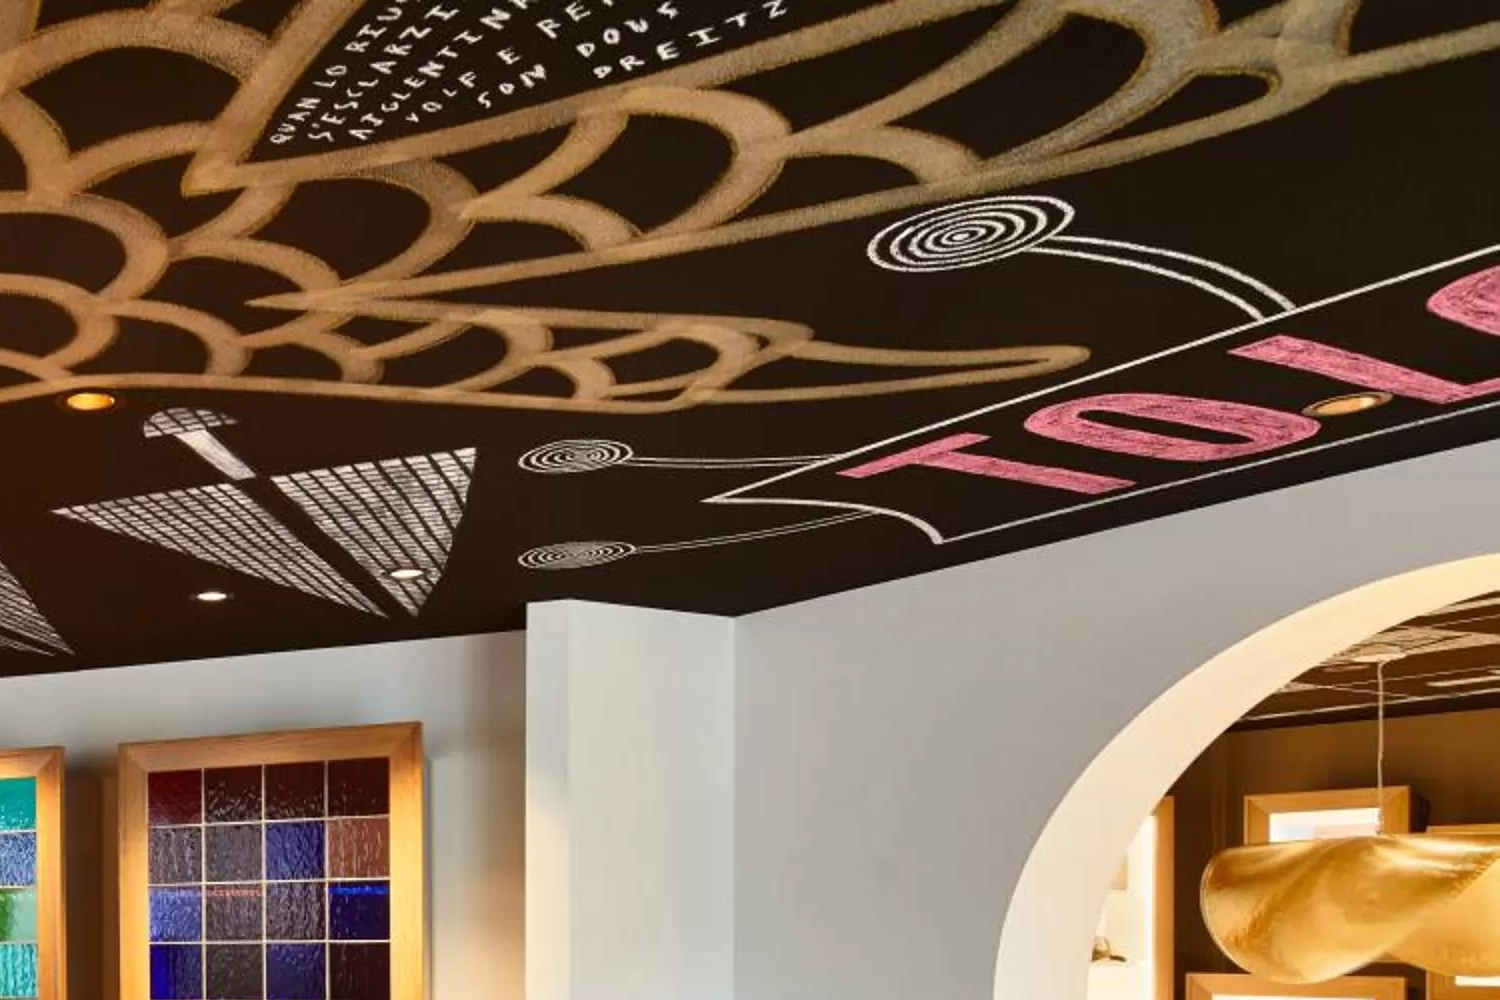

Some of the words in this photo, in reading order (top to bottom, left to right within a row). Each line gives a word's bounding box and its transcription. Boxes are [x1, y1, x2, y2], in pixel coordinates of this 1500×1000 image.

[269, 97, 321, 144] QUAN
[313, 64, 348, 89] LO
[345, 0, 421, 53] RIU
[496, 46, 522, 65] E
[536, 0, 614, 39] RE
[592, 0, 788, 79] DREITZ
[477, 63, 547, 109] SON
[836, 265, 1500, 494] TOL
